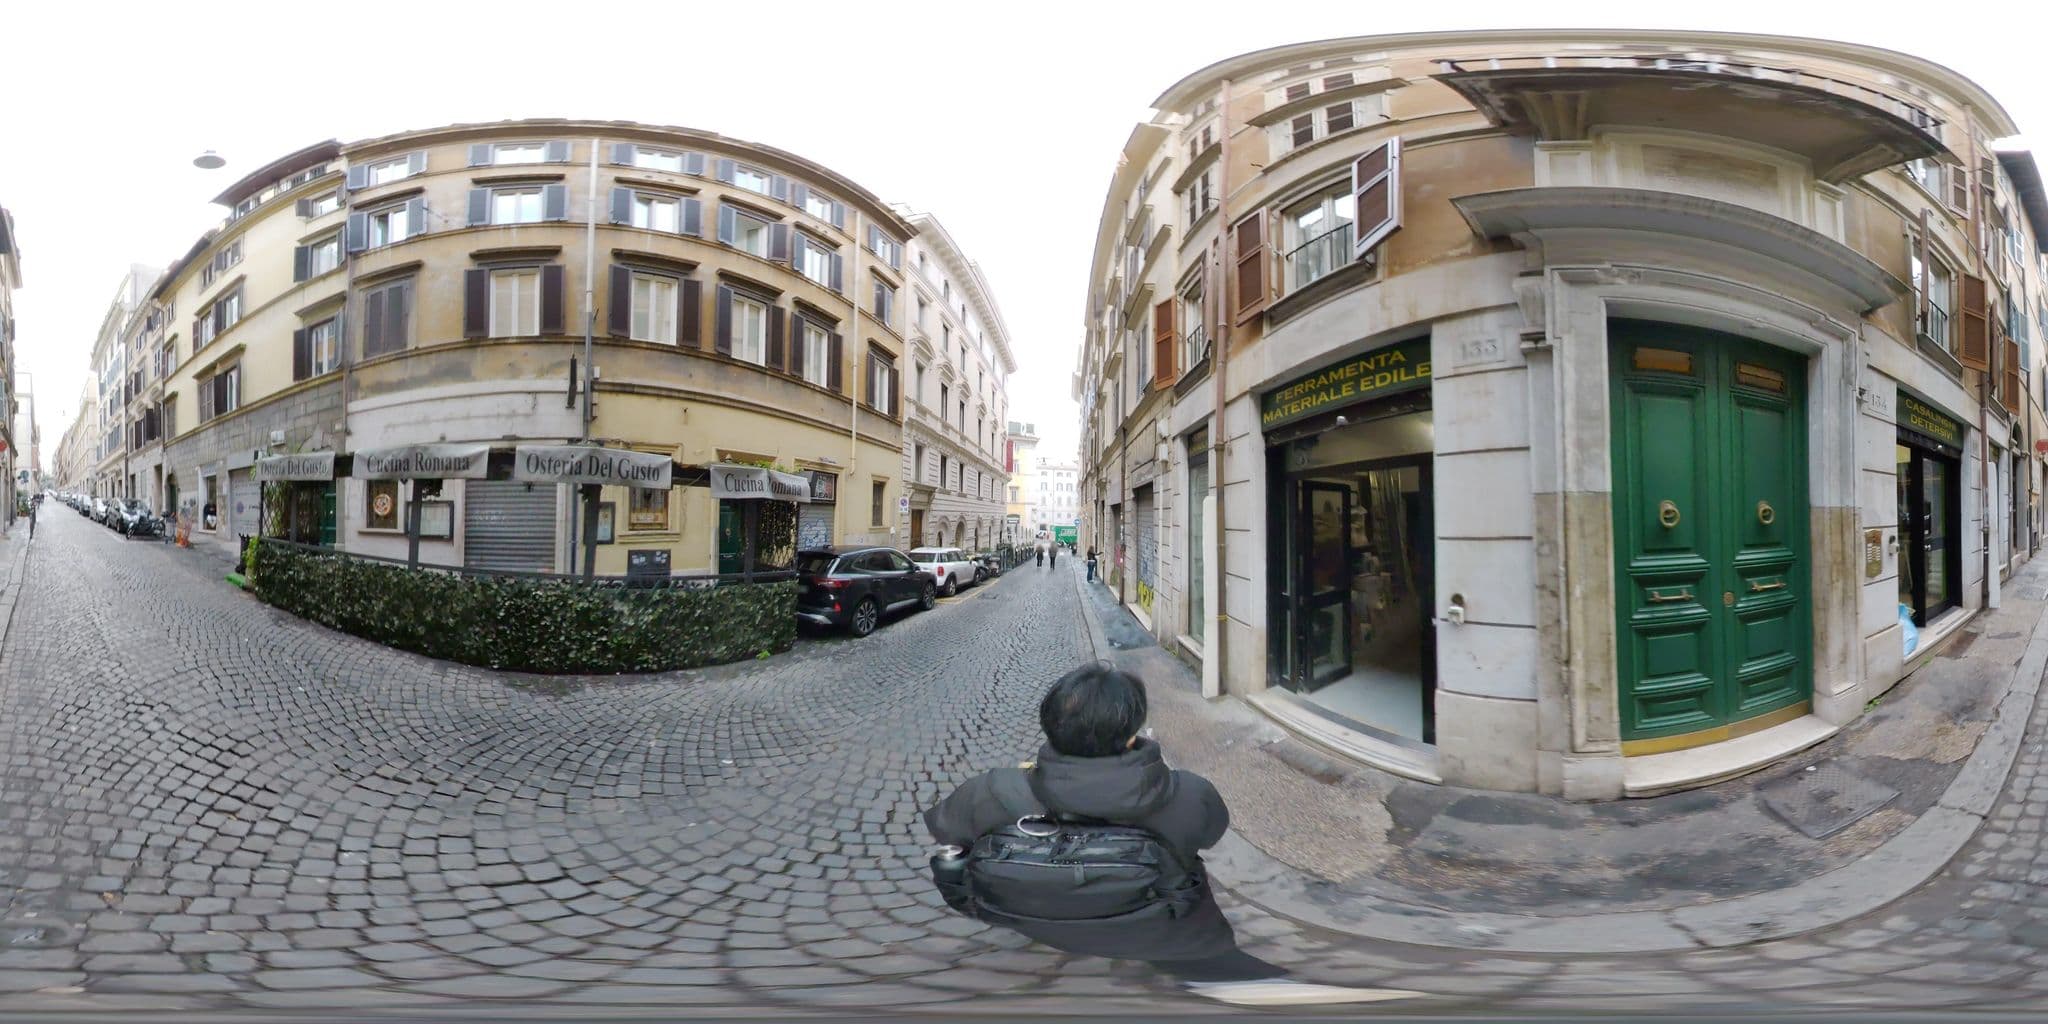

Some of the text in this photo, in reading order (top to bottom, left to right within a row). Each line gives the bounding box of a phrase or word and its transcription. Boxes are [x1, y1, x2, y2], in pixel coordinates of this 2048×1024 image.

[1275, 350, 1406, 404] FERRAMENTA
[1263, 362, 1432, 424] MATERIALE EDILE
[1911, 414, 1953, 440] DETERSIVI
[261, 459, 328, 475] Osteria Del Gusto
[367, 451, 470, 473] Cucina Romana
[526, 453, 660, 481] Osteria Del Gusto
[725, 473, 765, 492] Cucina
